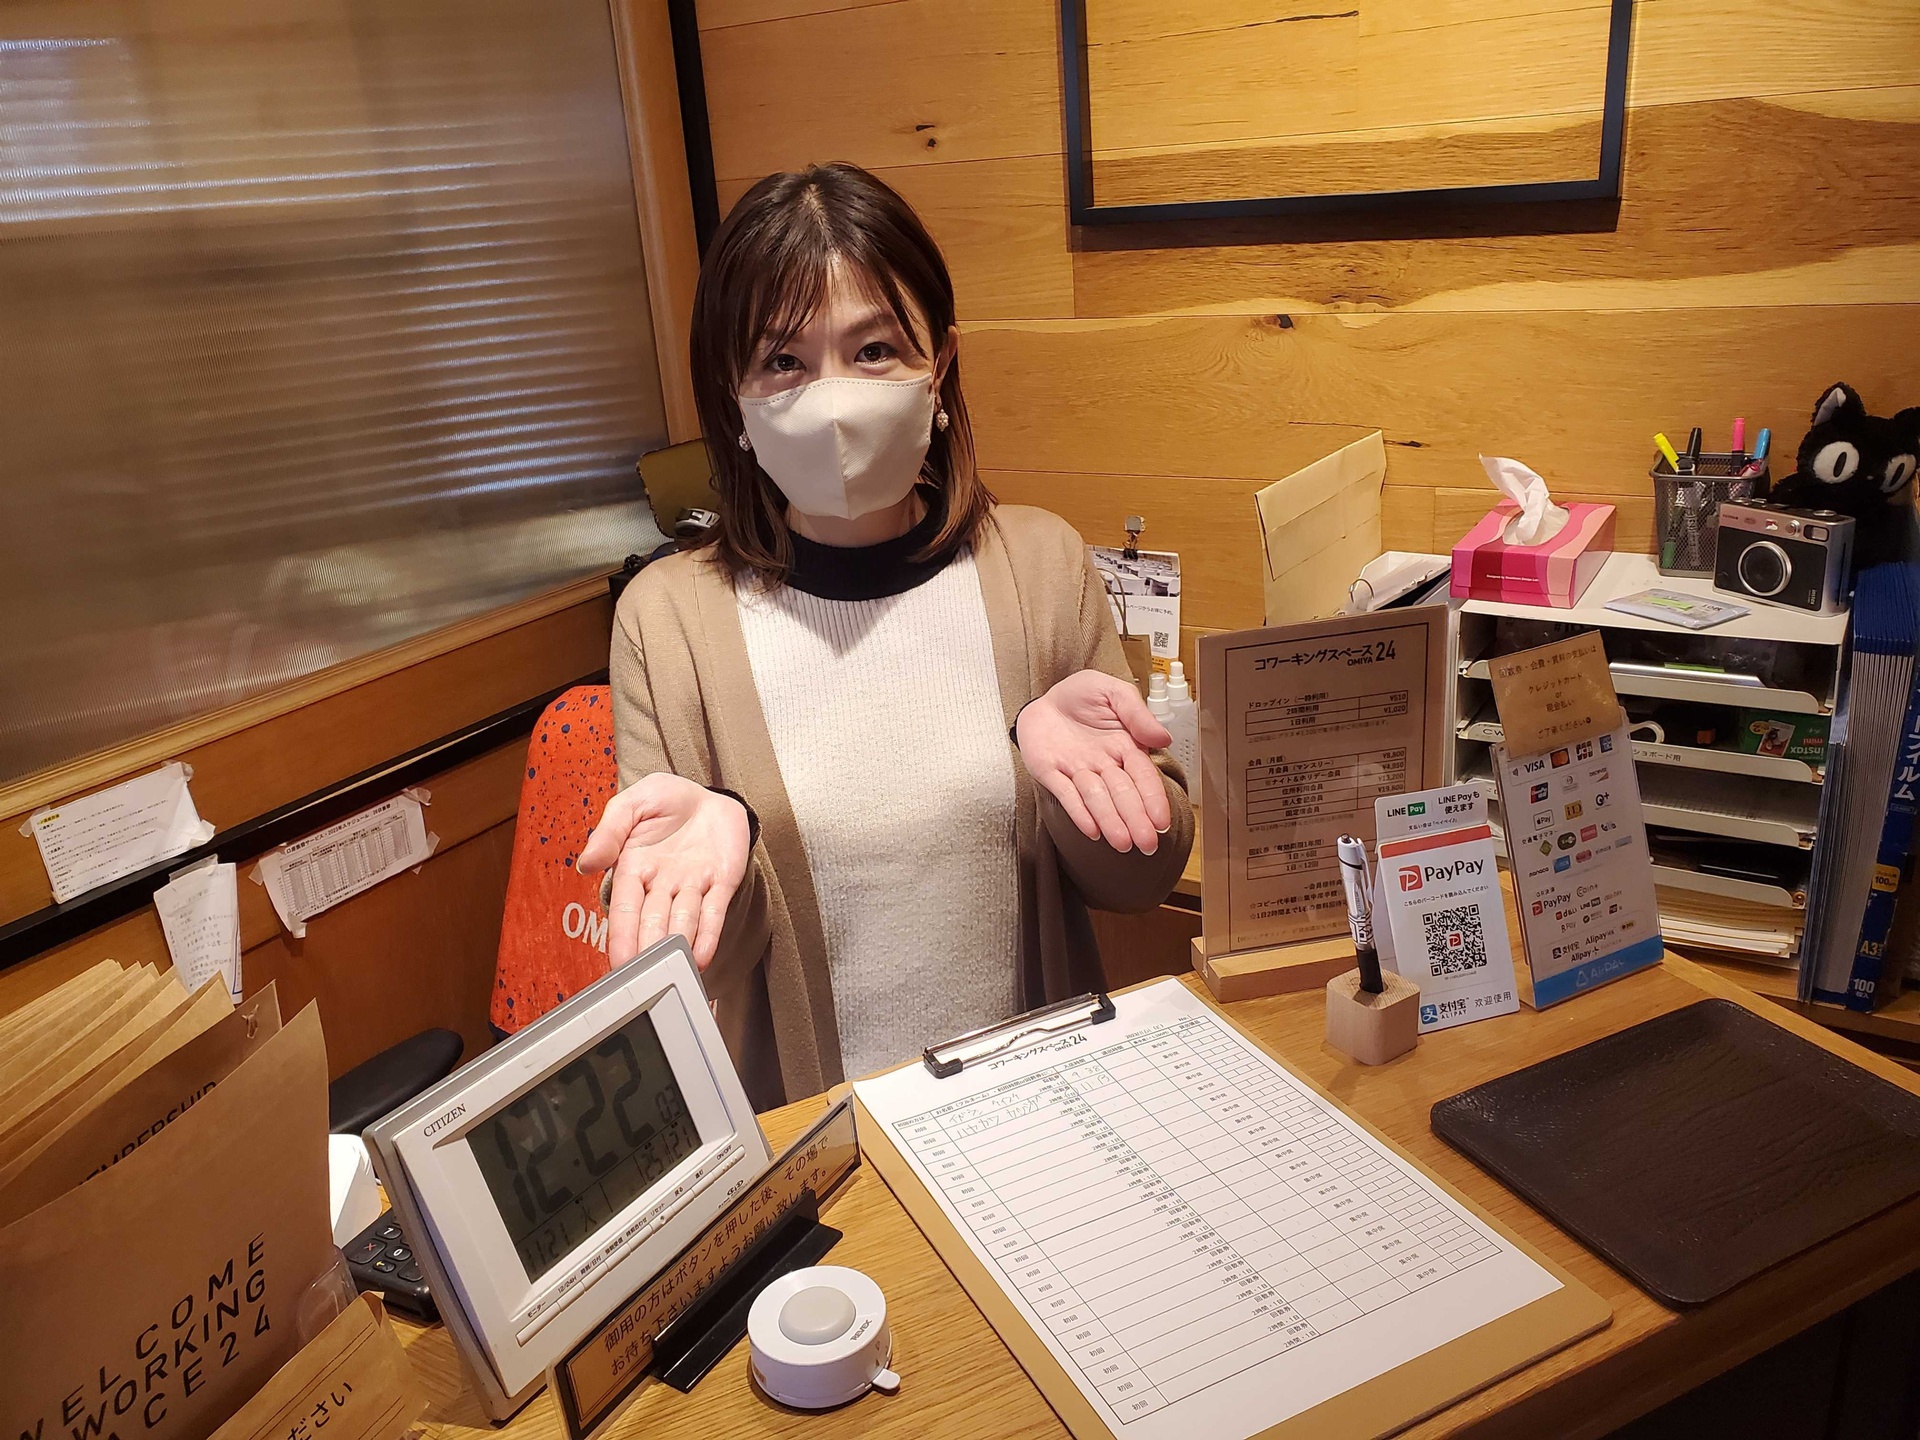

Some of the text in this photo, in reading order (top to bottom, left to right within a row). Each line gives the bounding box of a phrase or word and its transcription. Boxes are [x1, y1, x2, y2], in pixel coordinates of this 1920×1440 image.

[1254, 640, 1396, 671] コワーキングスペース 24
[1347, 658, 1373, 667] OMIYA
[1528, 673, 1583, 695] クレジットカード
[1555, 691, 1562, 699] or
[1286, 705, 1319, 716] 2時間利用
[1290, 716, 1316, 726] 1日利用
[1790, 746, 1824, 755] instax
[1524, 759, 1545, 773] VISA
[1438, 795, 1457, 805] LINE
[1387, 803, 1424, 817] LINE Pay
[1444, 802, 1474, 815] 使えます
[1424, 859, 1484, 881] PayPay
[1543, 892, 1572, 910] PayPay
[563, 902, 609, 953] OM
[1859, 940, 1877, 955] A3
[1853, 978, 1875, 993] 100
[1474, 991, 1512, 1007] 欢迎使用
[1441, 1009, 1467, 1020] ALIPAY
[987, 1033, 1088, 1070] コワーキングスペース 24
[423, 1102, 467, 1138] CITIZEN
[716, 1144, 733, 1160] ON/OFF
[650, 1202, 666, 1217] リセット
[1182, 1218, 1202, 1230] 回数券
[383, 1227, 394, 1235] 1
[1195, 1232, 1216, 1244] 回数券
[393, 1248, 403, 1257] 0
[1209, 1246, 1230, 1258] 回数券
[1224, 1260, 1245, 1273] 回数券
[557, 1276, 577, 1294] 12/24H
[1239, 1275, 1260, 1288] 回数券
[1254, 1290, 1275, 1303] 回数券
[527, 1301, 547, 1319] モニター
[1270, 1306, 1292, 1319] 回数券
[850, 1319, 873, 1341] REVEX
[1286, 1322, 1308, 1335] 回数券
